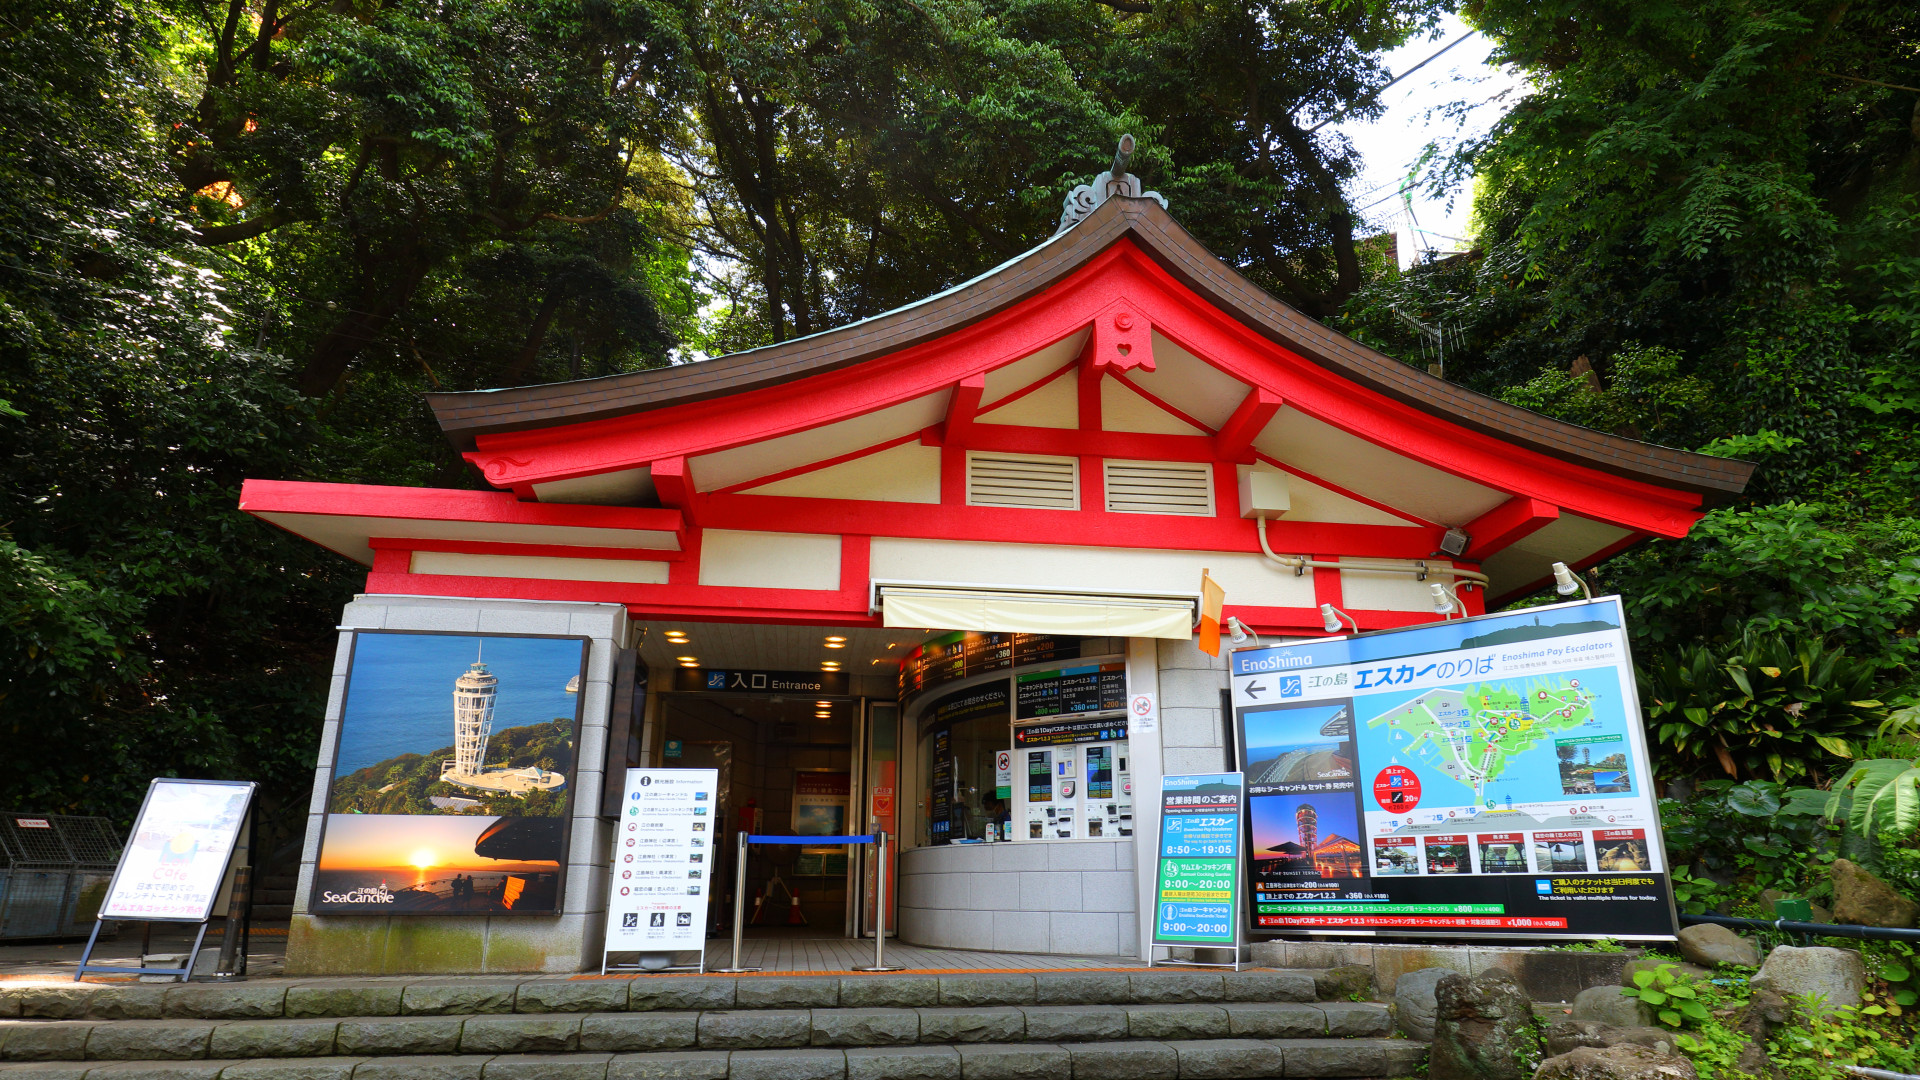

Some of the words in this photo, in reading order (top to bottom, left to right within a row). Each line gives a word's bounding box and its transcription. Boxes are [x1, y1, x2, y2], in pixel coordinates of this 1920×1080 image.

[1503, 651, 1544, 661] Enoshima
[1547, 648, 1563, 656] Pay
[1566, 642, 1612, 653] Escalators
[1242, 654, 1312, 672] EnoShima
[731, 673, 767, 689] 入口
[772, 681, 820, 690] Entrance
[1308, 673, 1348, 688] 江の島
[1165, 778, 1198, 786] EnoShima
[1166, 795, 1236, 805] 営業時間のご案内
[153, 867, 187, 880] Cafe
[137, 883, 194, 891] 日本で初めての
[1552, 878, 1654, 886] ご購入のチケットは当日何度でも
[116, 892, 208, 902] フレンチトースト専門店
[323, 890, 394, 903] SeaCandle
[1507, 919, 1532, 927] ¥1,000
